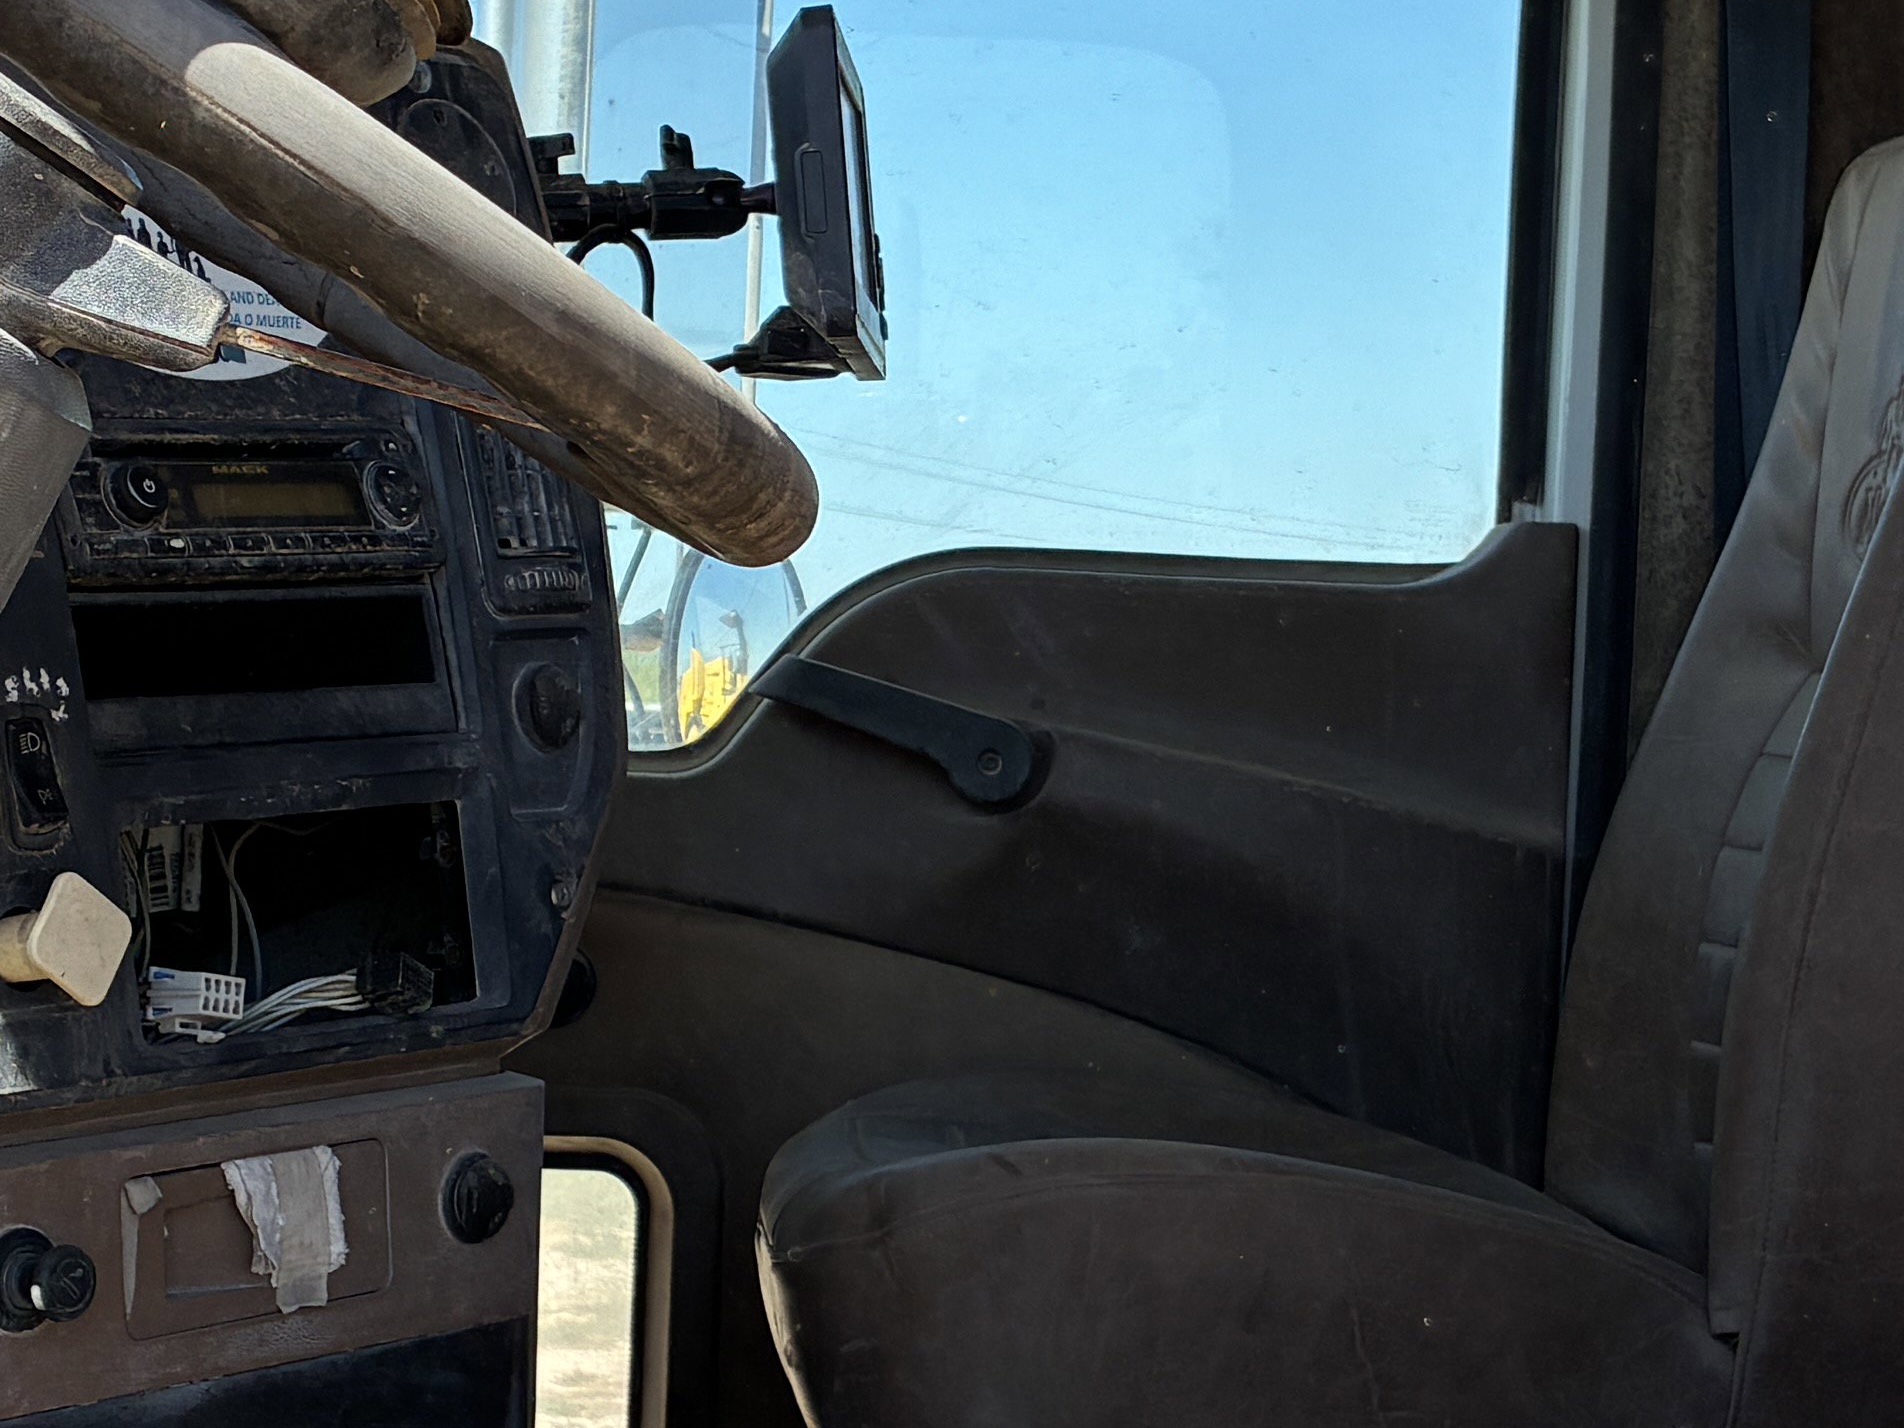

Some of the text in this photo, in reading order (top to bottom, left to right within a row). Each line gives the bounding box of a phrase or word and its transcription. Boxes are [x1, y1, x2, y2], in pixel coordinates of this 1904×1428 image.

[230, 290, 254, 305] AND
[244, 313, 254, 326] O
[256, 314, 302, 329] MUERTE
